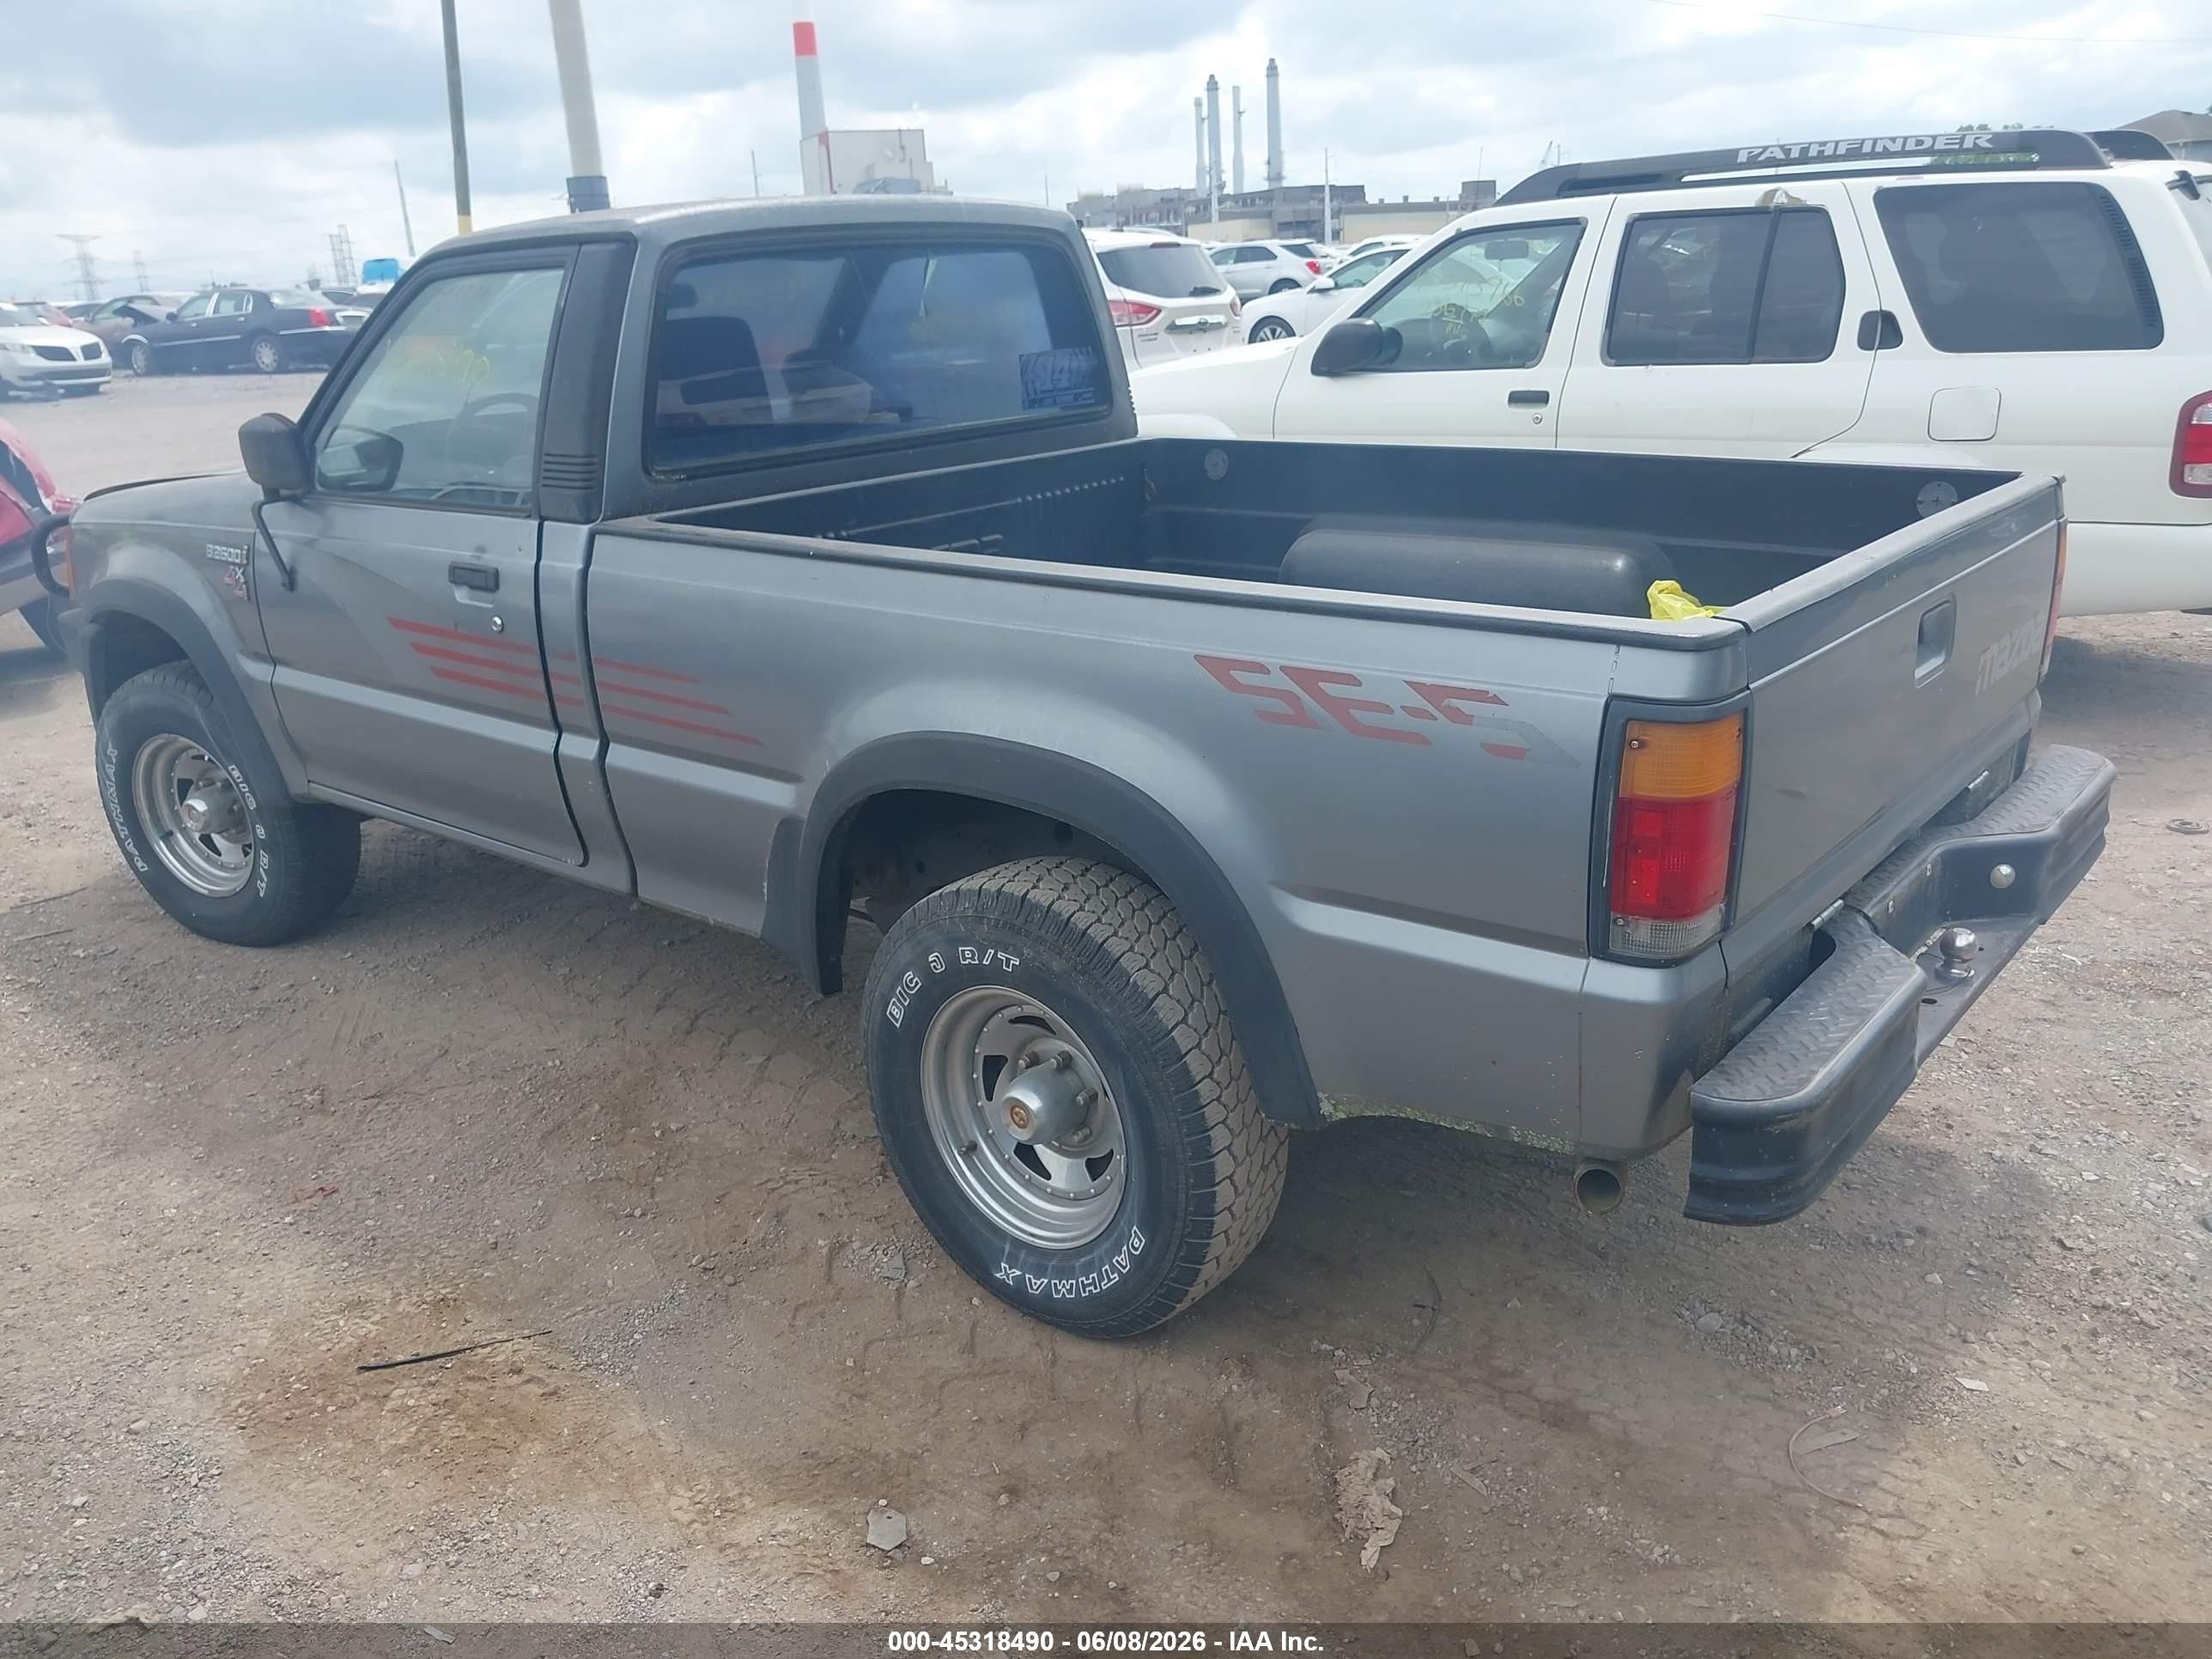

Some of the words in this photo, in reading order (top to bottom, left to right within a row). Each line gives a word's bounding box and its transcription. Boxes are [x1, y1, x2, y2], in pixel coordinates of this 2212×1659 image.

[1737, 134, 1993, 163] PATHFINDER
[1194, 654, 1578, 767] SE-5
[228, 764, 257, 810] BIG
[886, 971, 922, 1028] BIG
[958, 946, 1020, 972] R/T
[994, 1224, 1146, 1298] PATHMAX
